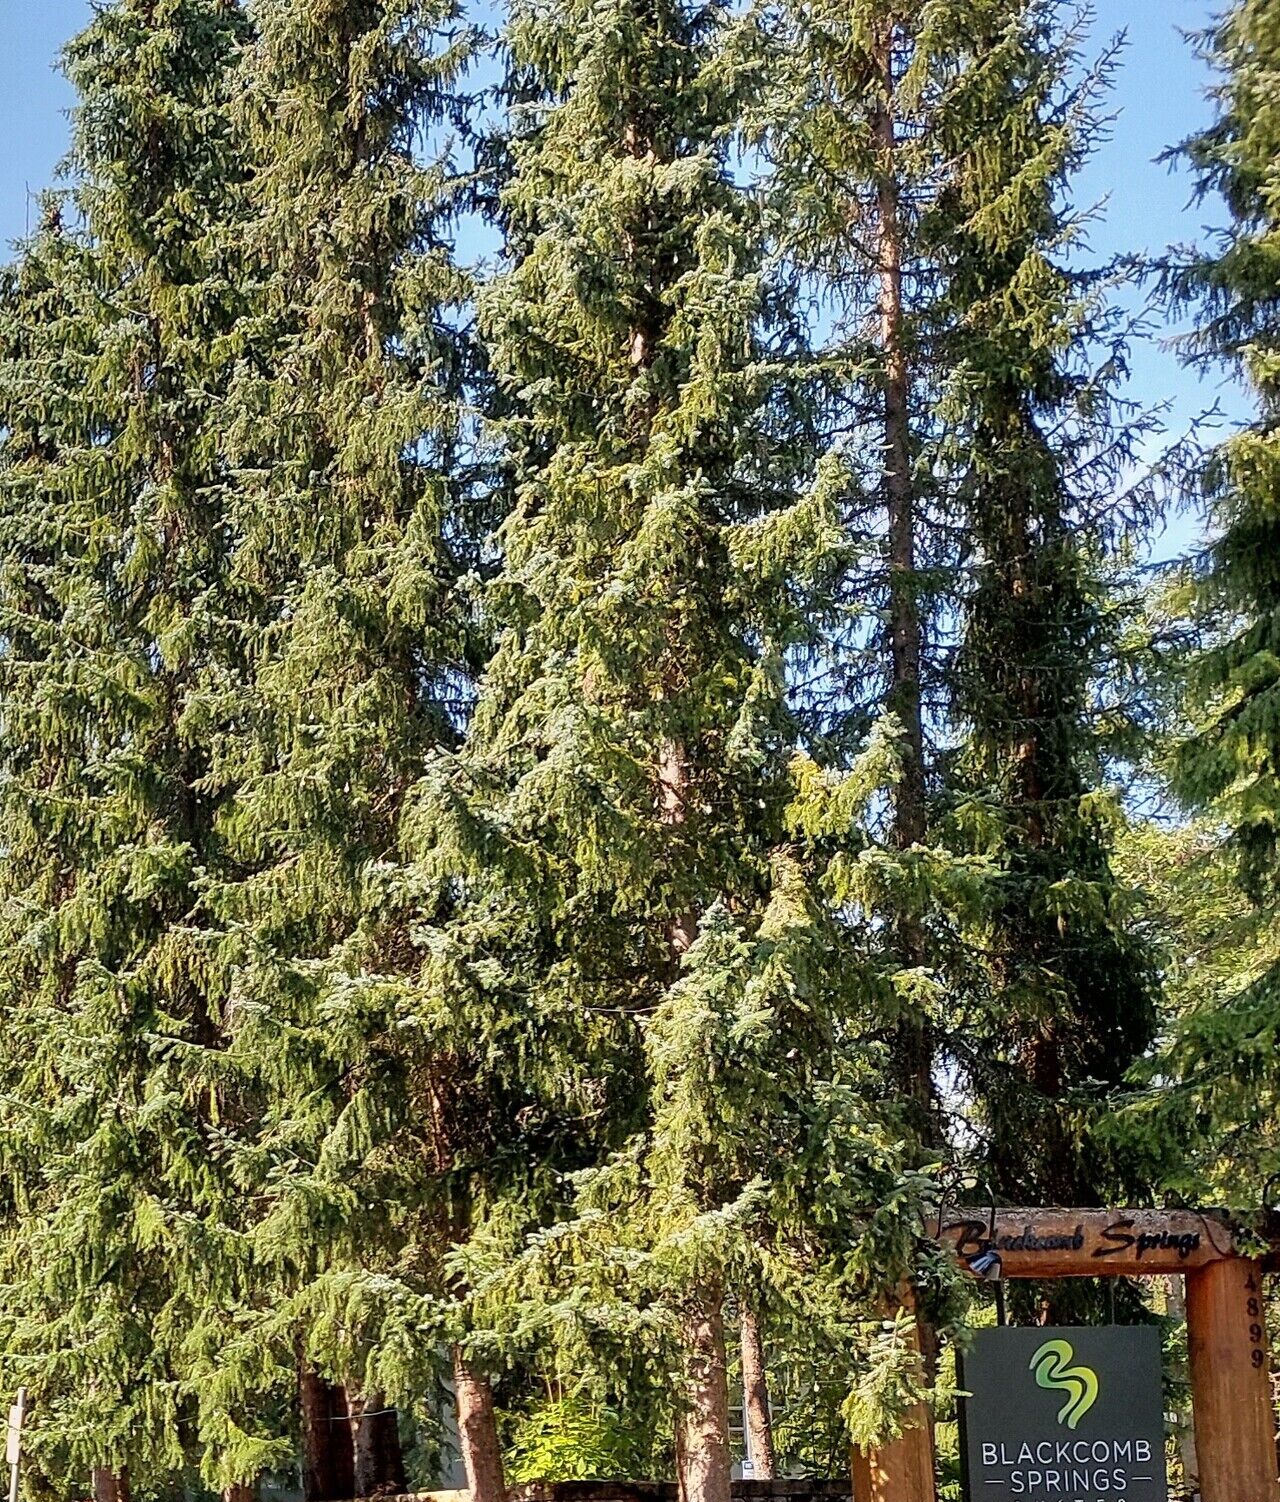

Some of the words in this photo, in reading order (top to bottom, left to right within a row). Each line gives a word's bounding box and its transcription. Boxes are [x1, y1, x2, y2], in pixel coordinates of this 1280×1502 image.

[1091, 1219, 1200, 1260] Springs
[981, 1440, 1152, 1466] BLACKCOMB
[1010, 1468, 1128, 1494] SPRINGS
